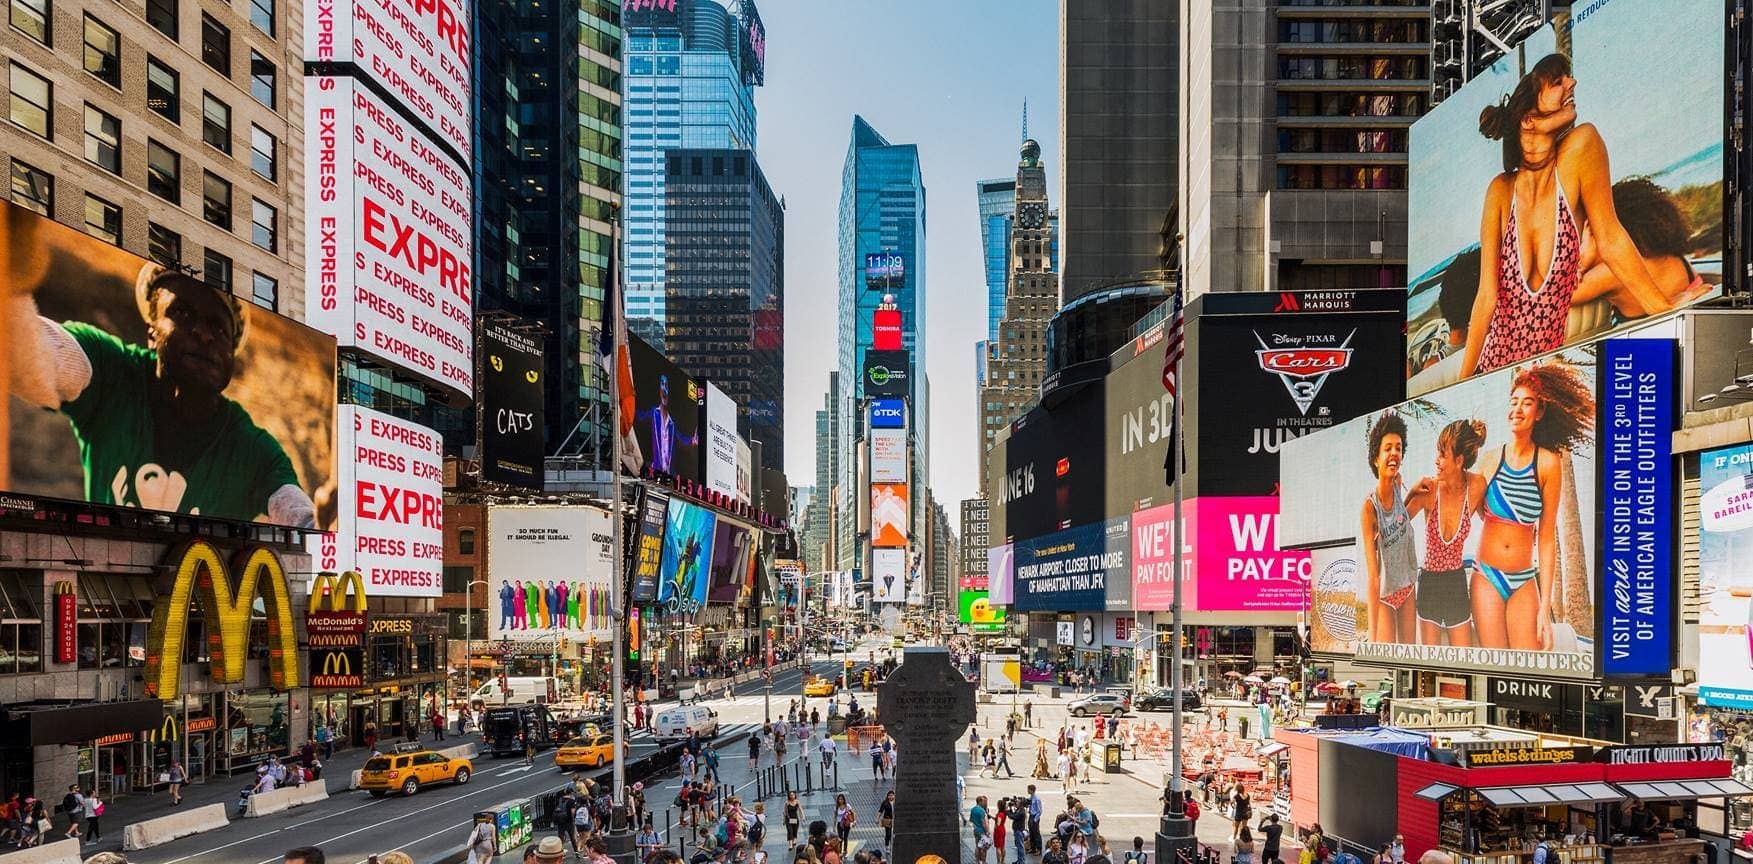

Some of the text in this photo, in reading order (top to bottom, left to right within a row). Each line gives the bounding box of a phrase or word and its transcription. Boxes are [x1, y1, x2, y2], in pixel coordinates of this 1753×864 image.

[377, 0, 434, 57] XPRESS
[373, 53, 434, 120] EXPRESS
[410, 54, 463, 117] EXPRESS
[320, 108, 336, 202] EXPRESS
[373, 138, 435, 197] EXPRESS
[410, 136, 463, 192] EXPRESS
[412, 200, 464, 249] EXPRESS
[321, 217, 336, 311] EXPRESS
[374, 261, 436, 308] EXPRESS
[1304, 292, 1356, 300] MARRIOTT
[1304, 300, 1350, 310] MARQUIS
[412, 315, 464, 355] EXPRESS
[1272, 333, 1336, 346] Disney PIXAR
[374, 330, 436, 370] EXPRESS
[1268, 352, 1341, 369] Cars
[1615, 353, 1633, 400] LEVEL
[1294, 381, 1316, 404] 3
[497, 408, 534, 435] CATS
[880, 409, 902, 417] TDK
[1122, 392, 1175, 455] IN 3D
[1276, 418, 1333, 427] IN THEATRES
[371, 419, 432, 452] EXPRESS
[356, 446, 406, 473] PRESS
[1614, 440, 1632, 464] THE
[1715, 456, 1727, 467] IF
[997, 468, 1023, 507] JUNE
[1023, 460, 1035, 496] 16
[1614, 470, 1632, 491] ON
[1637, 372, 1656, 640] OF AMERICAN EAGLE OUTFITTERS
[1614, 497, 1632, 552] INSIDE
[356, 536, 406, 556] PRESS
[372, 568, 432, 588] EXPRESS
[638, 562, 658, 576] AWAY
[1018, 550, 1123, 580] NEWARK AIRPORT: CLOSER TO MORE
[1136, 564, 1156, 584] PAY
[1227, 558, 1275, 580] PAY
[1028, 572, 1104, 593] OF MANHATTAN THAN JFK
[1613, 558, 1631, 614] aerie
[308, 618, 364, 626] McDonald's
[370, 620, 412, 632] XPRESS
[1612, 616, 1630, 661] VISIT
[1356, 642, 1593, 672] AMERICAN EAGLE OUTFITTERS
[1497, 680, 1552, 700] DRINK
[1470, 748, 1574, 765] wafels&dinges
[1610, 746, 1725, 766] MIGHTY QUINN'S BBQ
